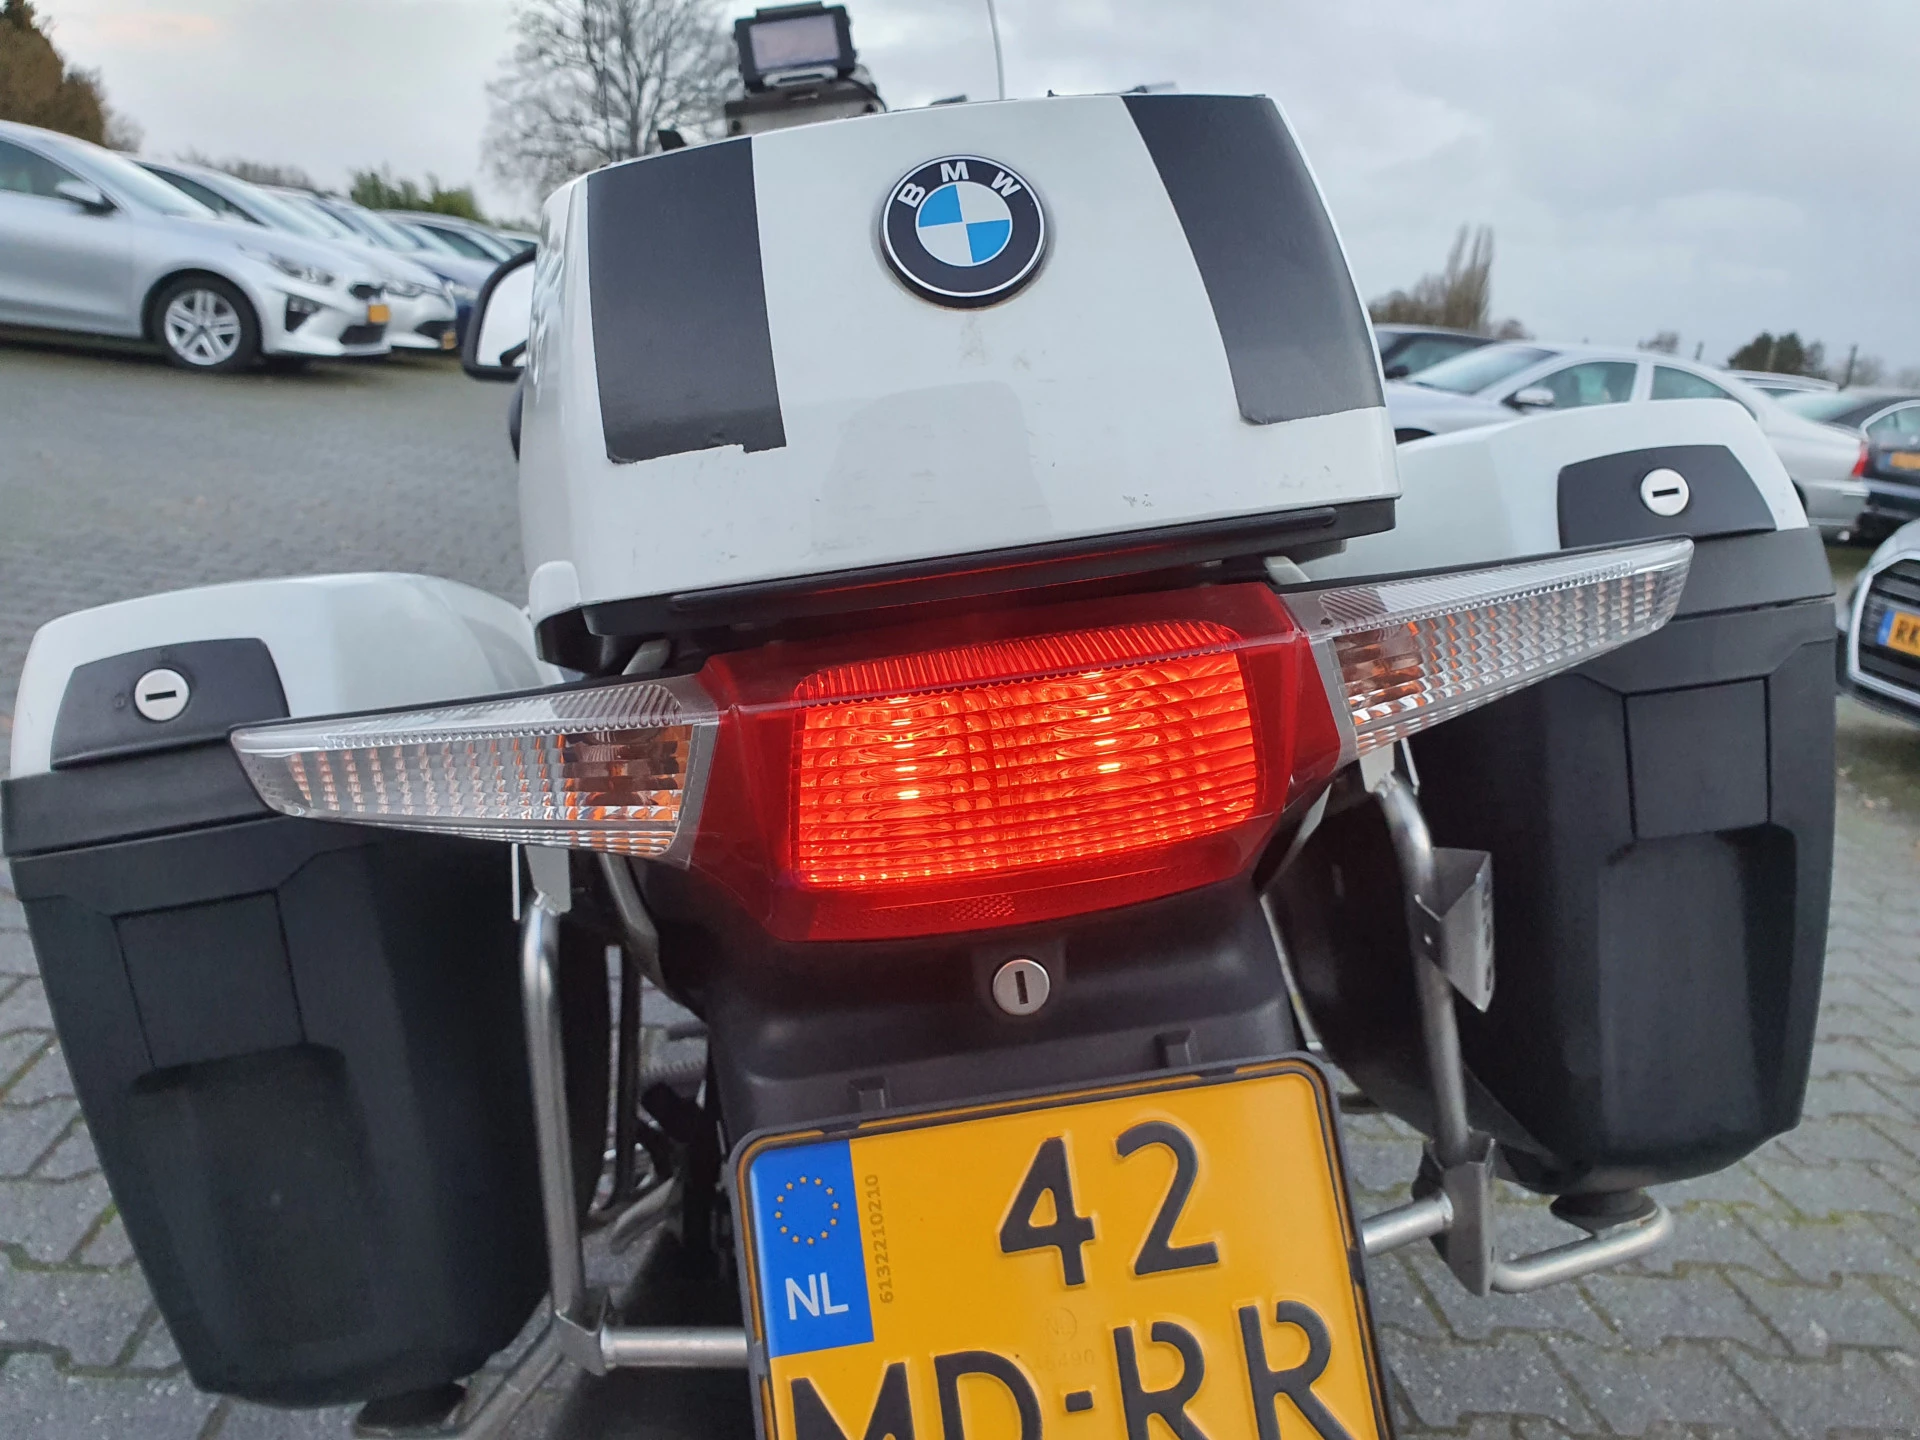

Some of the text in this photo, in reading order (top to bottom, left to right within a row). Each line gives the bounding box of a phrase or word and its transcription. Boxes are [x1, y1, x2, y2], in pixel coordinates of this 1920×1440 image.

[897, 161, 1022, 208] BMW
[864, 1174, 894, 1304] 6132210210
[999, 1120, 1220, 1287] 42
[785, 1271, 849, 1320] NL
